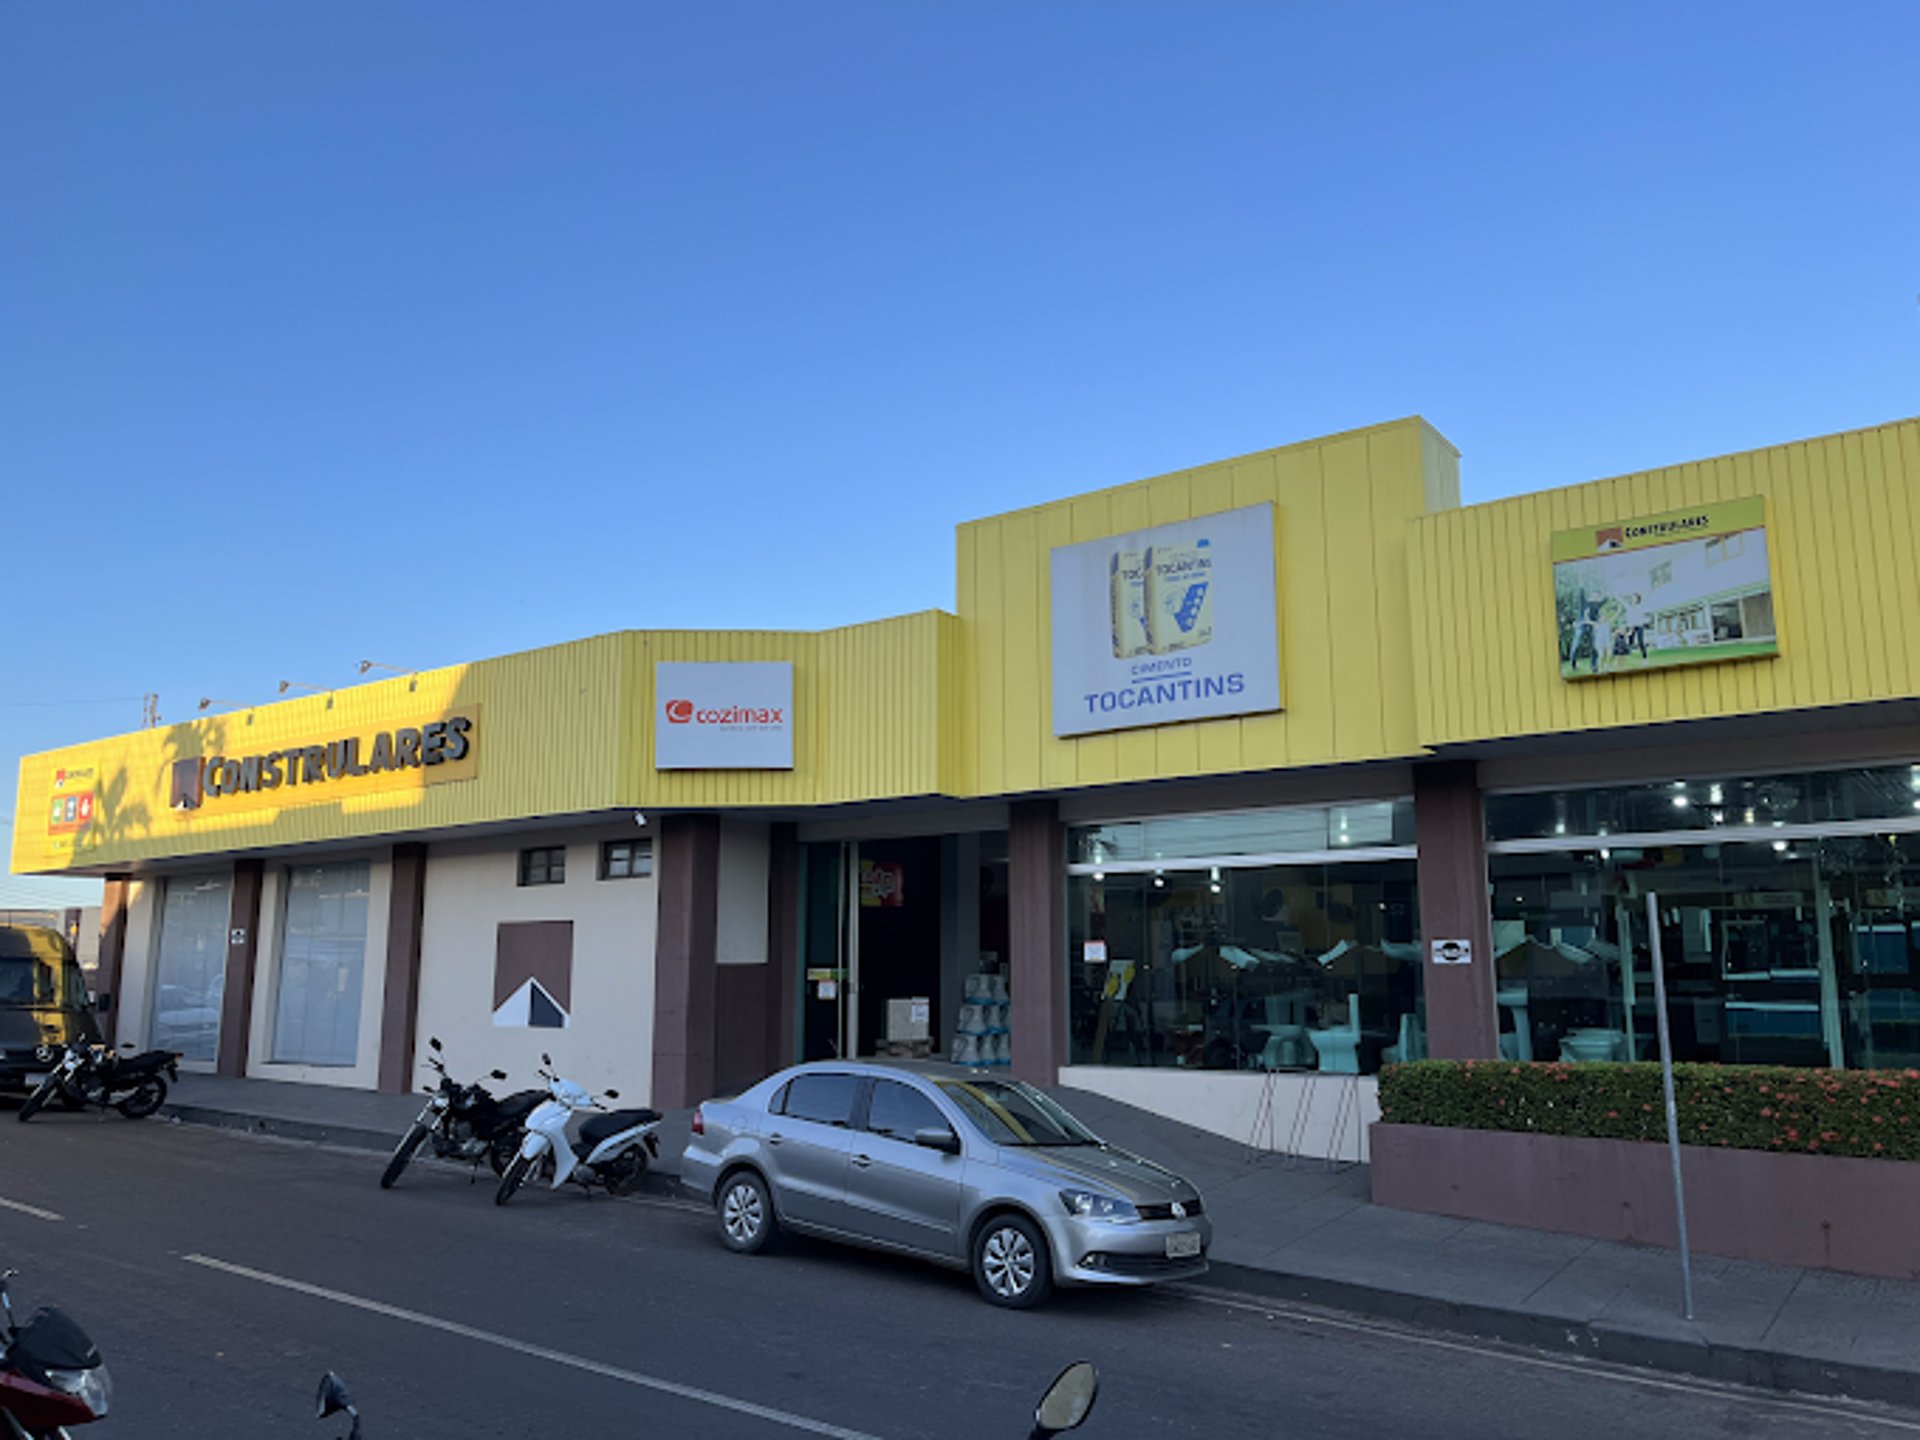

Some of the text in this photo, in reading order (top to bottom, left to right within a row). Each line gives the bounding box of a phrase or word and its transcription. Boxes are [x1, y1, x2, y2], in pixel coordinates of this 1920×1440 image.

[1625, 515, 1709, 538] CONSTRULARES
[1122, 567, 1144, 580] TOC
[1084, 673, 1245, 713] TOCANTINS
[696, 704, 783, 724] cozimax
[202, 716, 473, 797] CONSTRULARES
